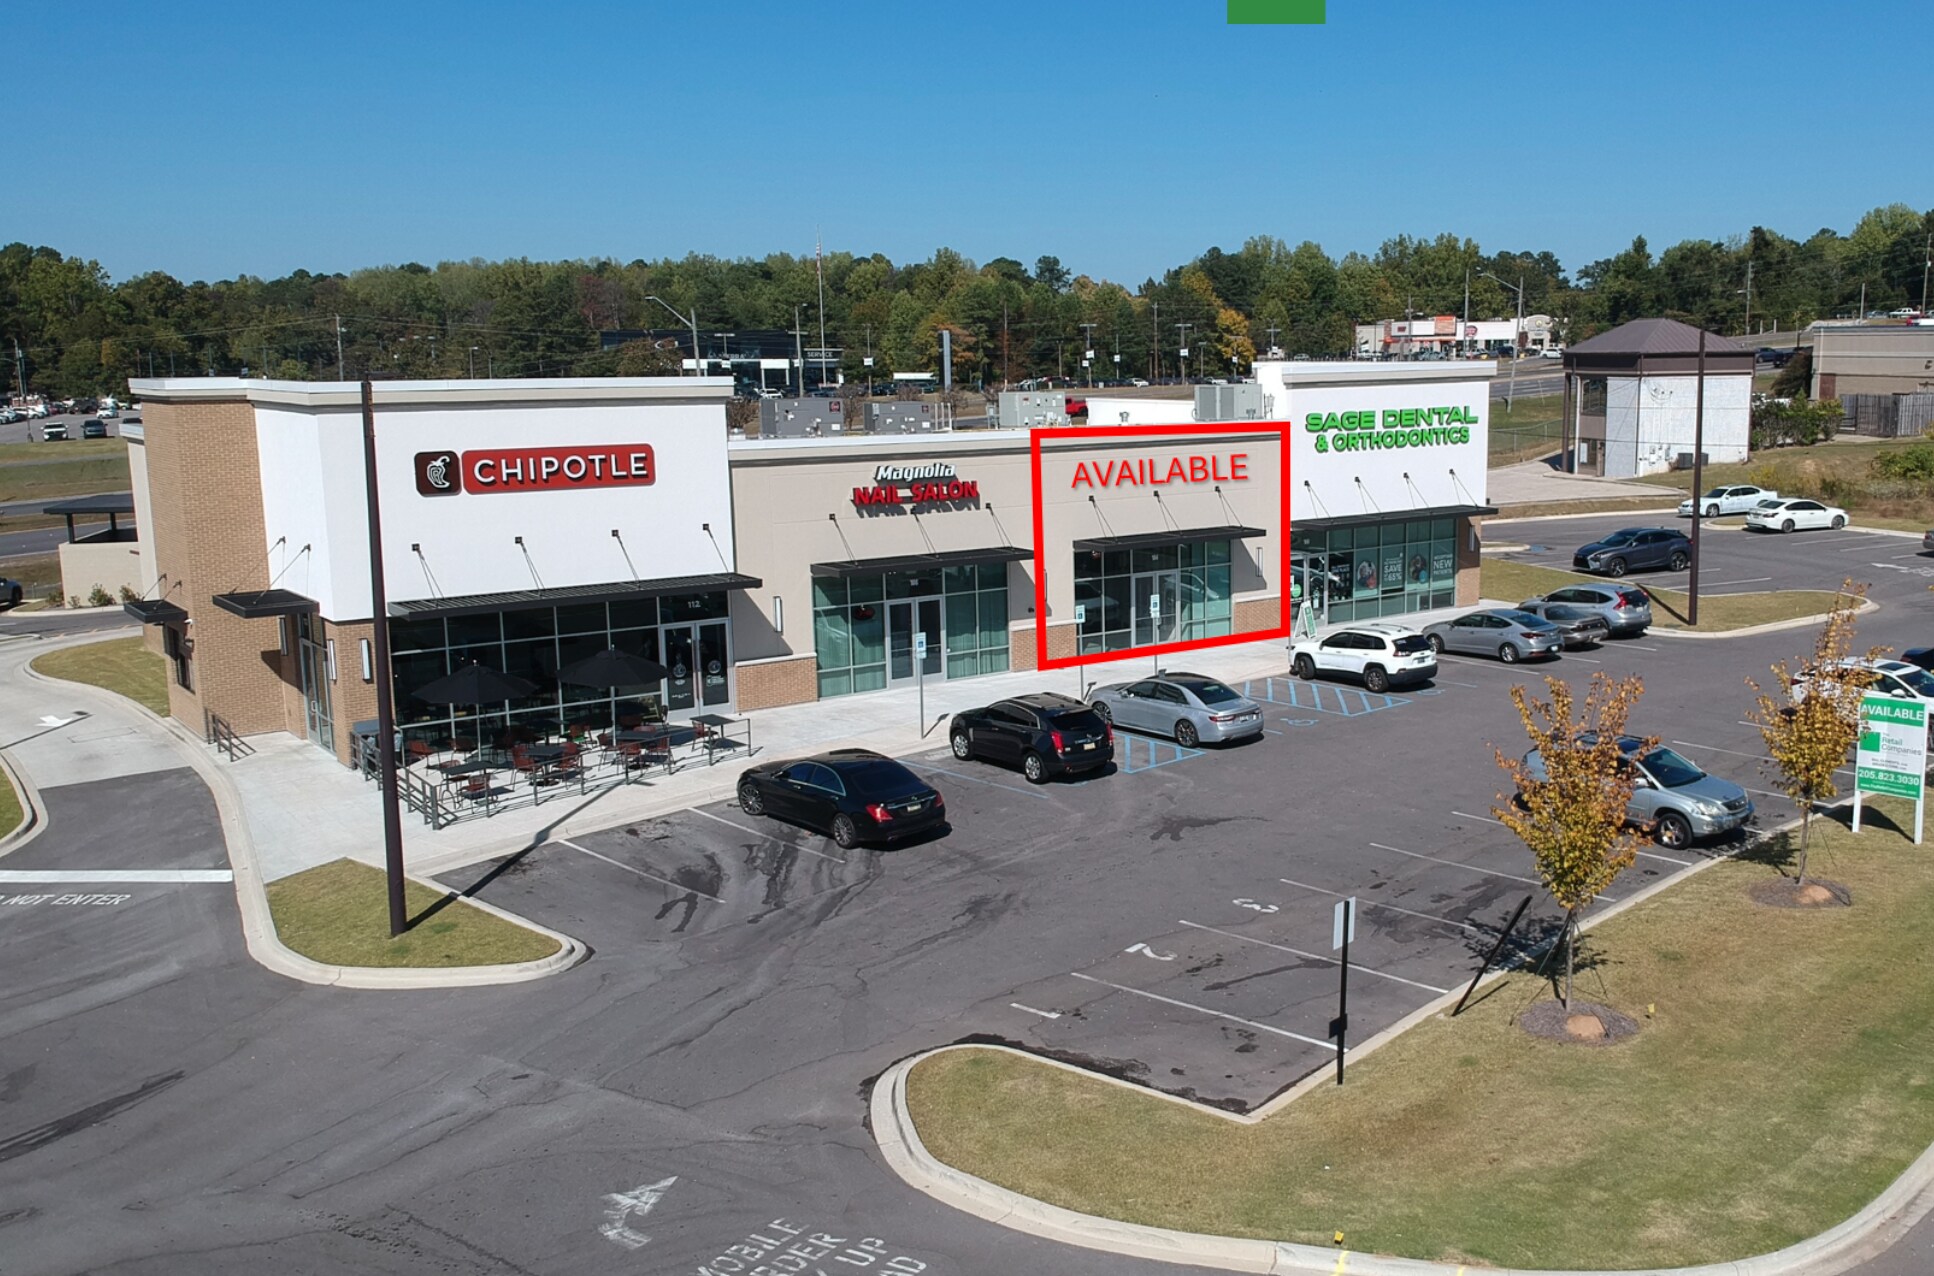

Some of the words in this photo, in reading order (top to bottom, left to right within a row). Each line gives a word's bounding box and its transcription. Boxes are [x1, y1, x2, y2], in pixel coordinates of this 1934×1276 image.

[1305, 411, 1376, 432] SAGE
[1382, 405, 1479, 428] DENTAL
[1314, 434, 1329, 453] &
[1332, 426, 1470, 452] ORTHODONTICS
[473, 452, 649, 484] CHIPOTLE
[876, 462, 957, 482] Magnolia
[853, 485, 903, 505] NAIL
[910, 480, 979, 503] SALON
[1384, 563, 1402, 574] SAVE
[1433, 559, 1453, 570] NEW
[688, 600, 700, 609] 112
[1861, 703, 1925, 721] AVAILABLE
[1881, 736, 1903, 746] Retail
[1881, 743, 1922, 756] Companies
[1858, 769, 1920, 786] 205.823.3030
[1, 893, 56, 906] NOT
[50, 893, 132, 906] ENTER
[834, 1237, 888, 1267] UP
